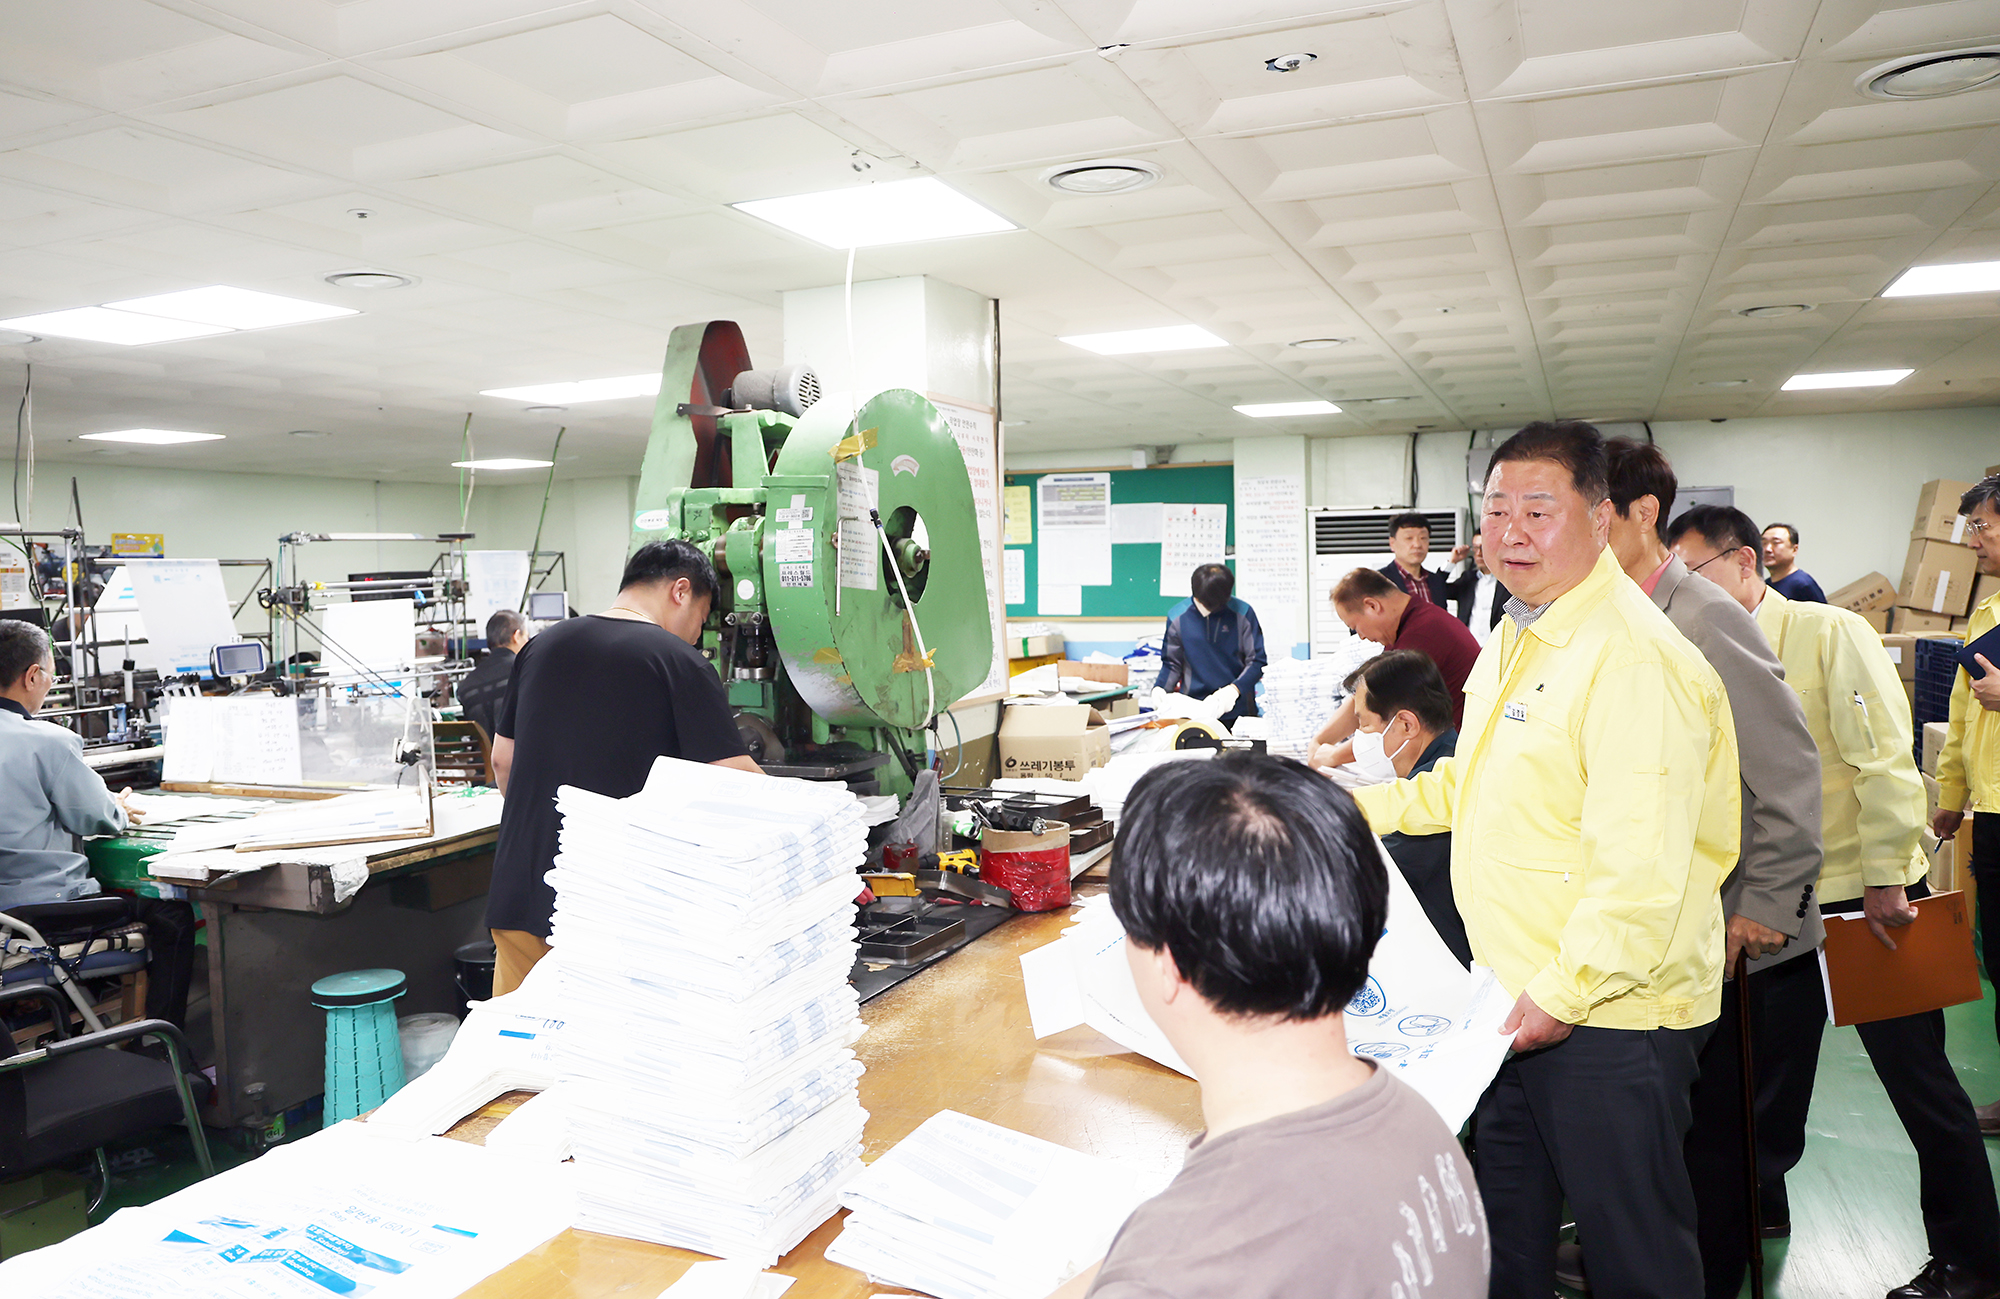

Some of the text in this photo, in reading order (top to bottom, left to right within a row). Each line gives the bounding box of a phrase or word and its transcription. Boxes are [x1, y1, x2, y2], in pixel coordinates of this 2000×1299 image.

[1192, 507, 1196, 515] 4
[1020, 760, 1076, 772] 쓰레기봉투
[286, 1260, 315, 1278] doorstep.
